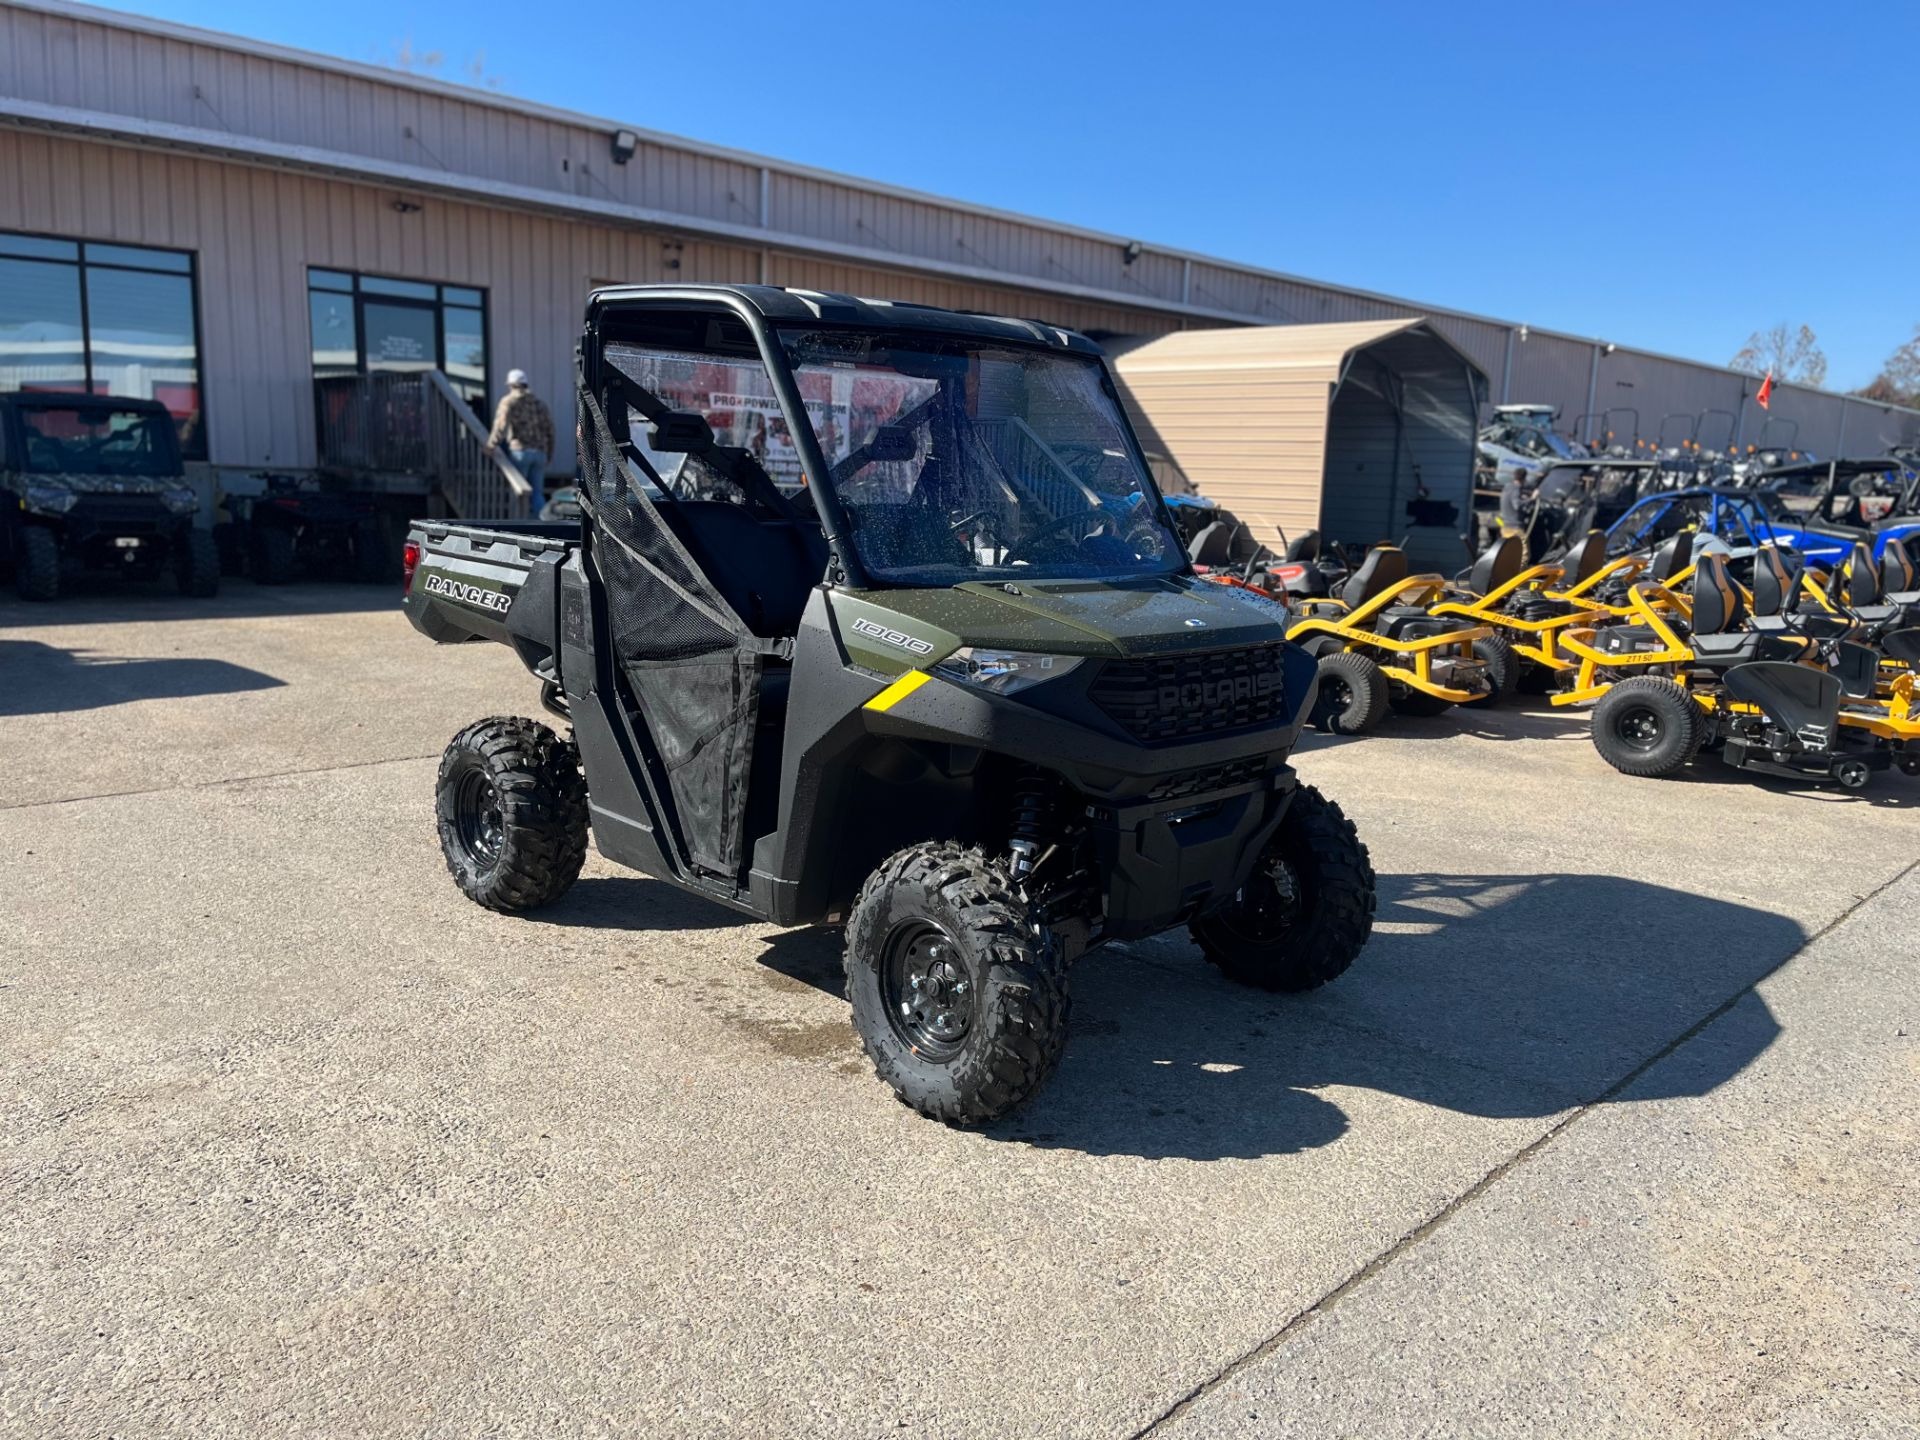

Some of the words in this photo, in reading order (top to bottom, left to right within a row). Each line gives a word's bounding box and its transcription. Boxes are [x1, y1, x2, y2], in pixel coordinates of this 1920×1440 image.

[424, 574, 512, 613] RANGER
[851, 617, 934, 655] 1000
[1158, 671, 1282, 711] POLARIS
